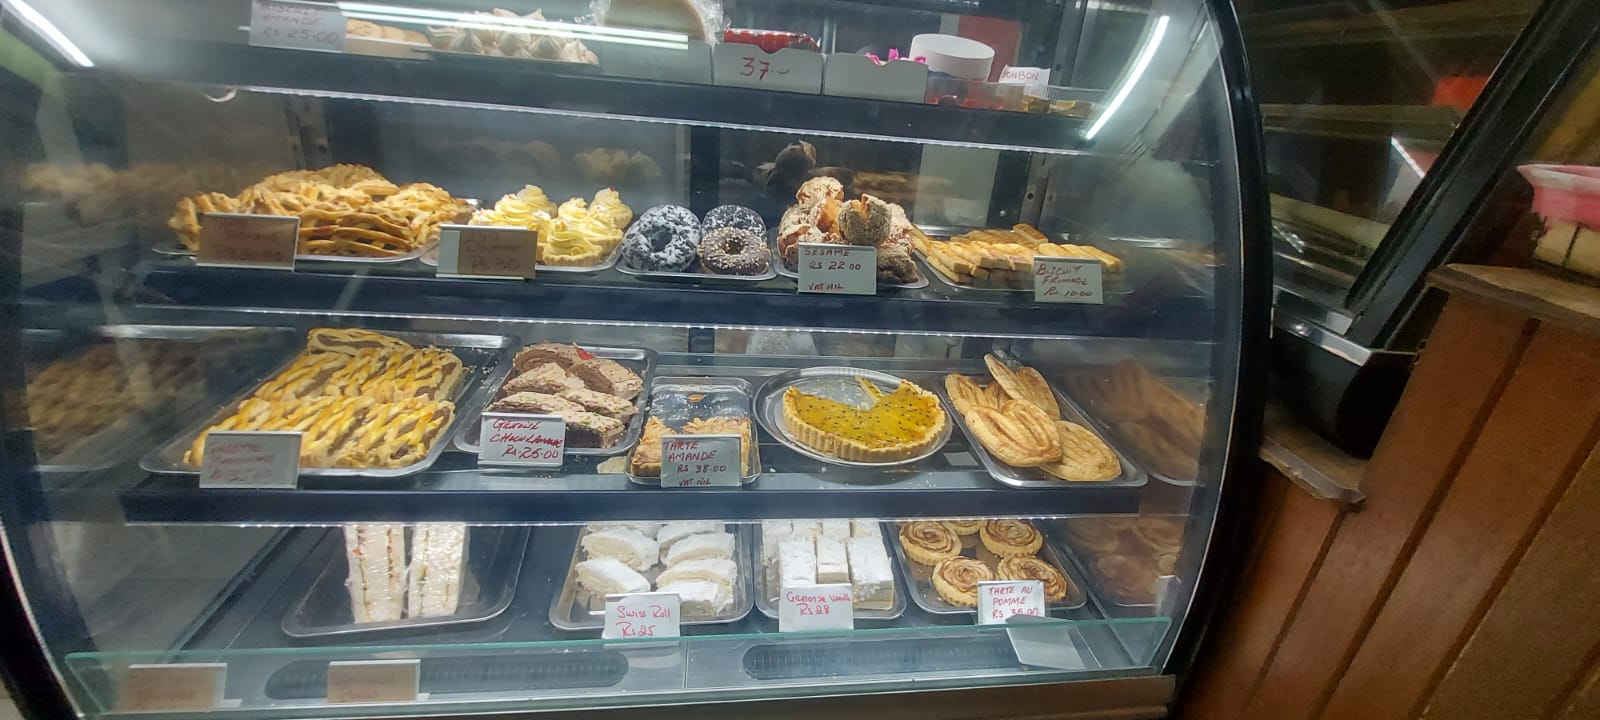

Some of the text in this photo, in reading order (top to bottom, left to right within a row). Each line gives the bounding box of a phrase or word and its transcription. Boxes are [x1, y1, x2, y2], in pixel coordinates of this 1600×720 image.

[663, 440, 700, 451] TARTE
[668, 450, 718, 462] AMANDE
[679, 478, 693, 487] VAT
[988, 585, 1033, 595] TARTE AU
[992, 597, 1027, 606] POMME
[649, 604, 672, 619] Roll
